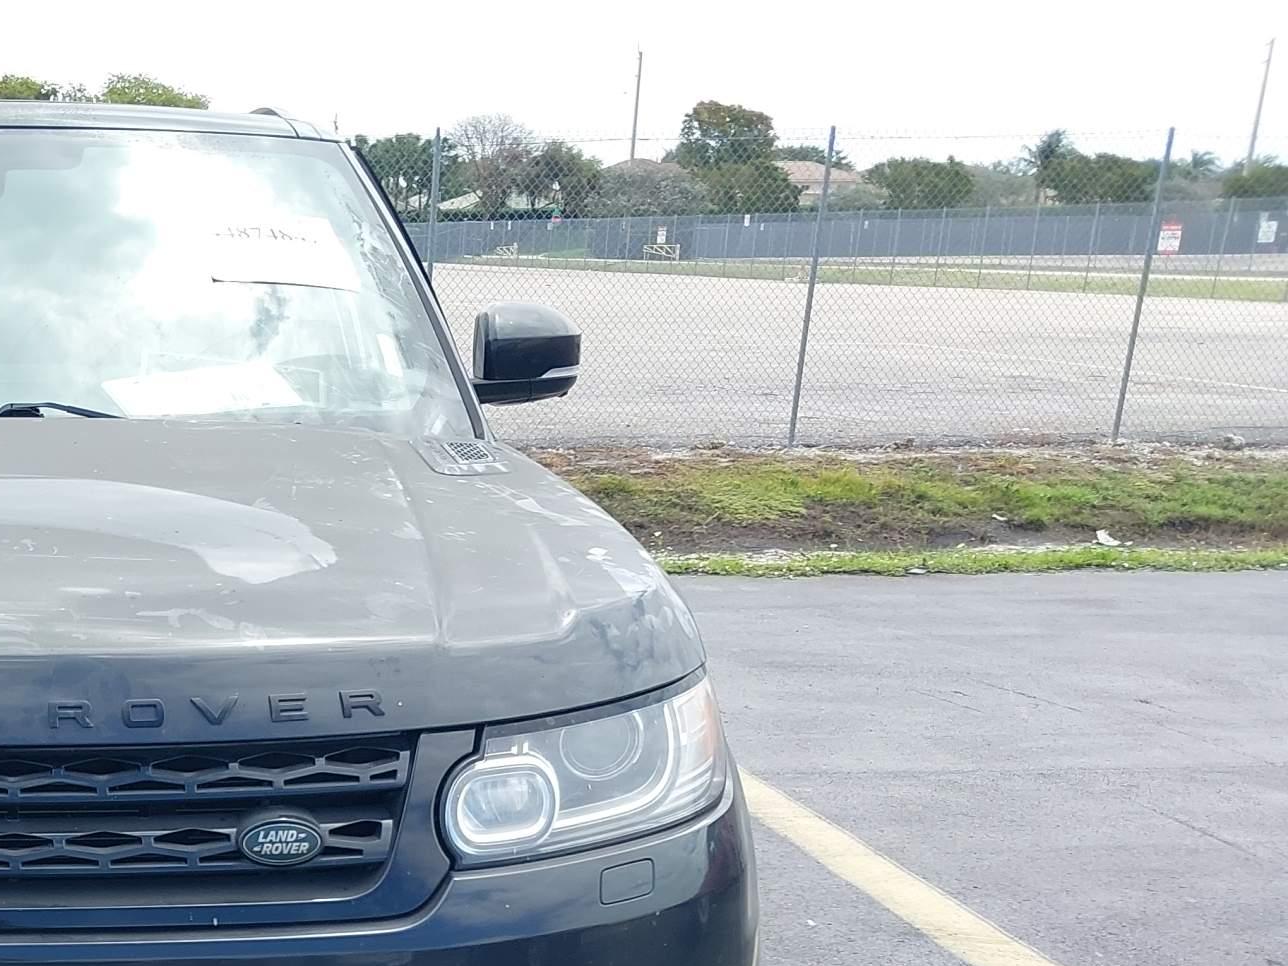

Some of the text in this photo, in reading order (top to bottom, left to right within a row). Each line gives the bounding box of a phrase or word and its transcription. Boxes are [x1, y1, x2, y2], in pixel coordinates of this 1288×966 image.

[48, 688, 386, 730] ROVER
[257, 830, 298, 842] LAND
[261, 842, 310, 855] ROVER
